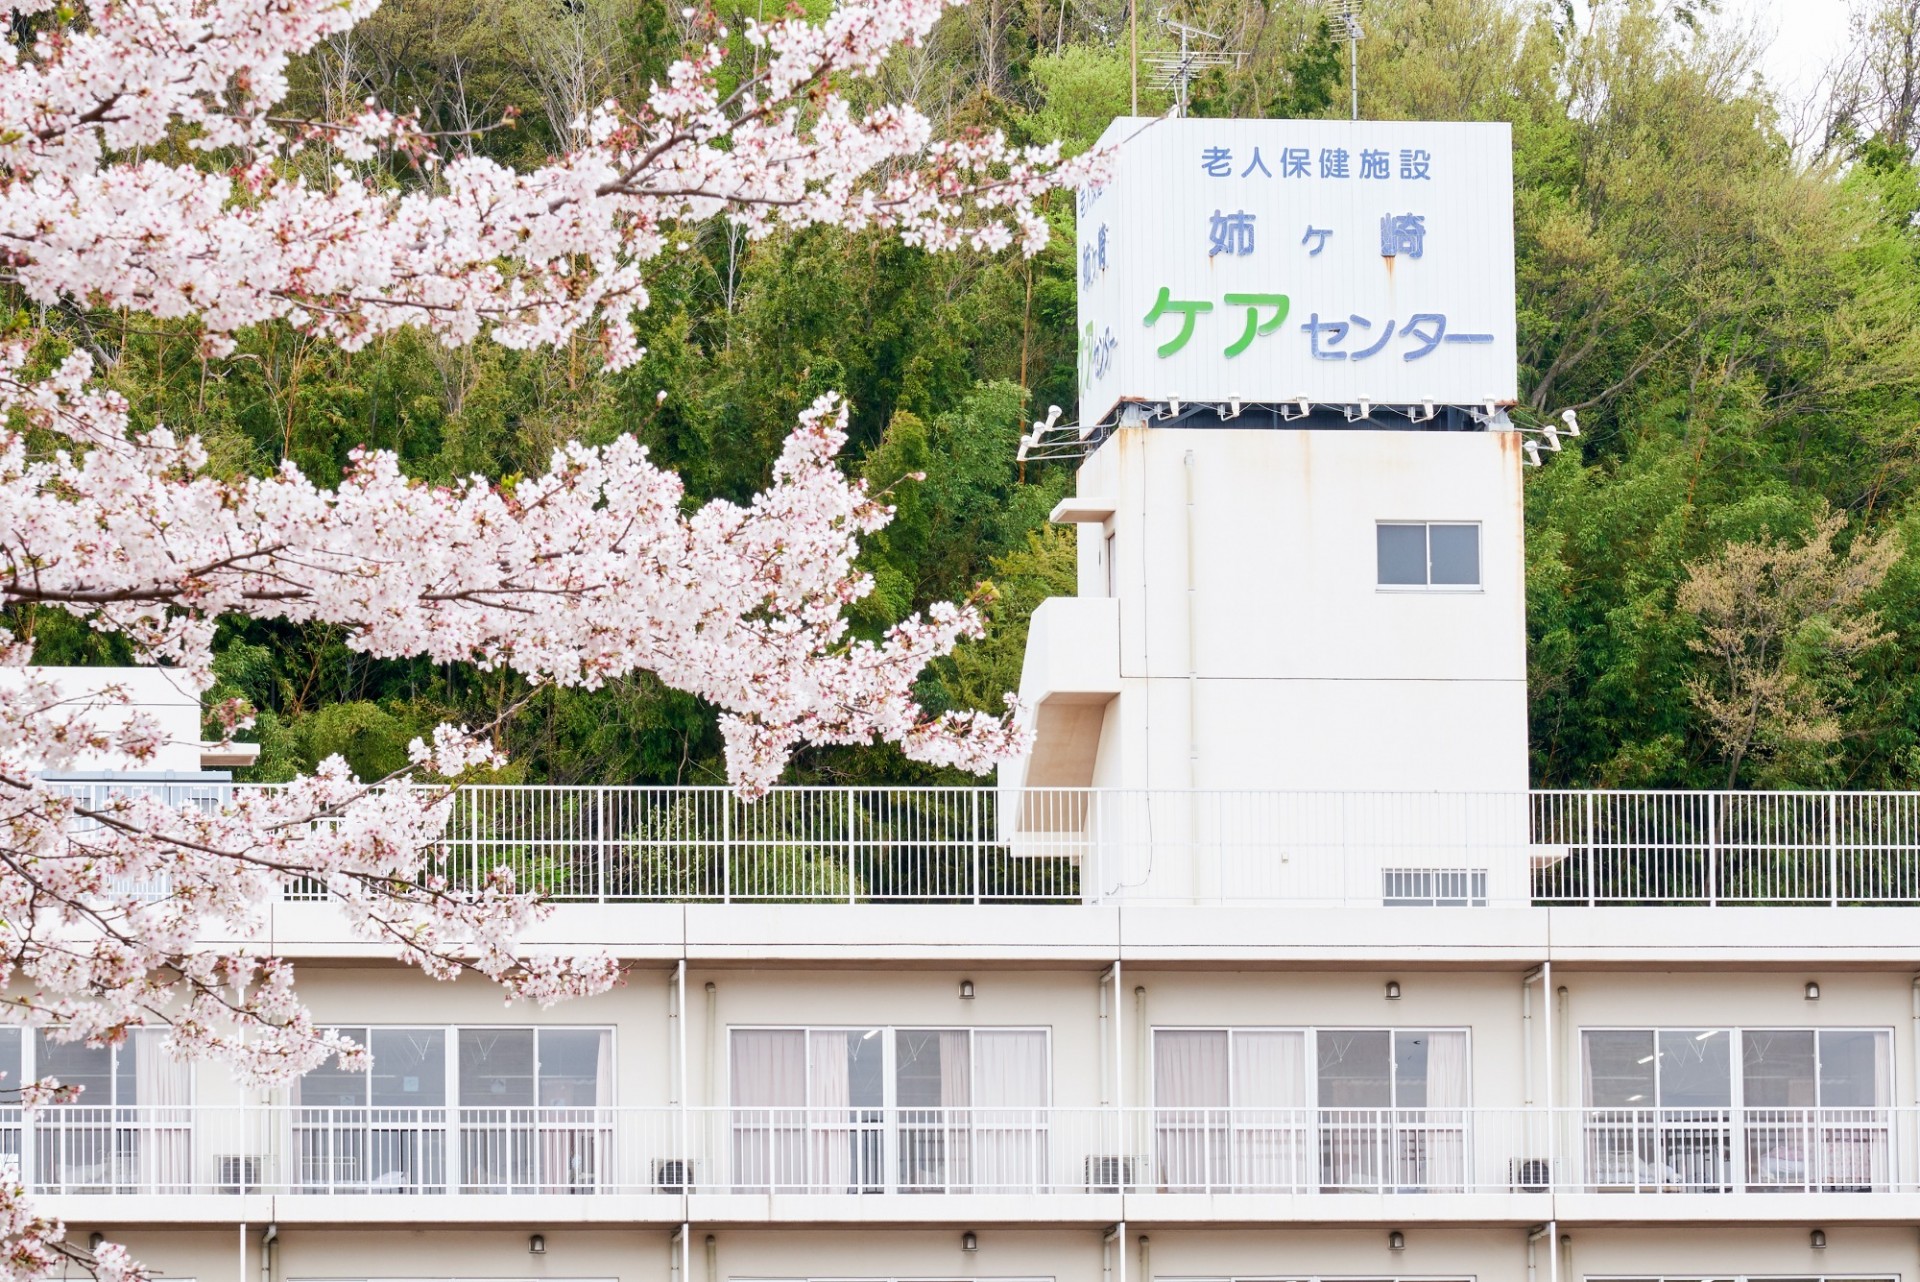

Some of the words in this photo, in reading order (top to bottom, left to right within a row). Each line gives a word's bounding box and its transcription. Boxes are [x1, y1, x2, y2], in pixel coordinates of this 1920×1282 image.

[1201, 146, 1431, 180] 老人保健施設
[1143, 286, 1495, 362] ケアセンター
